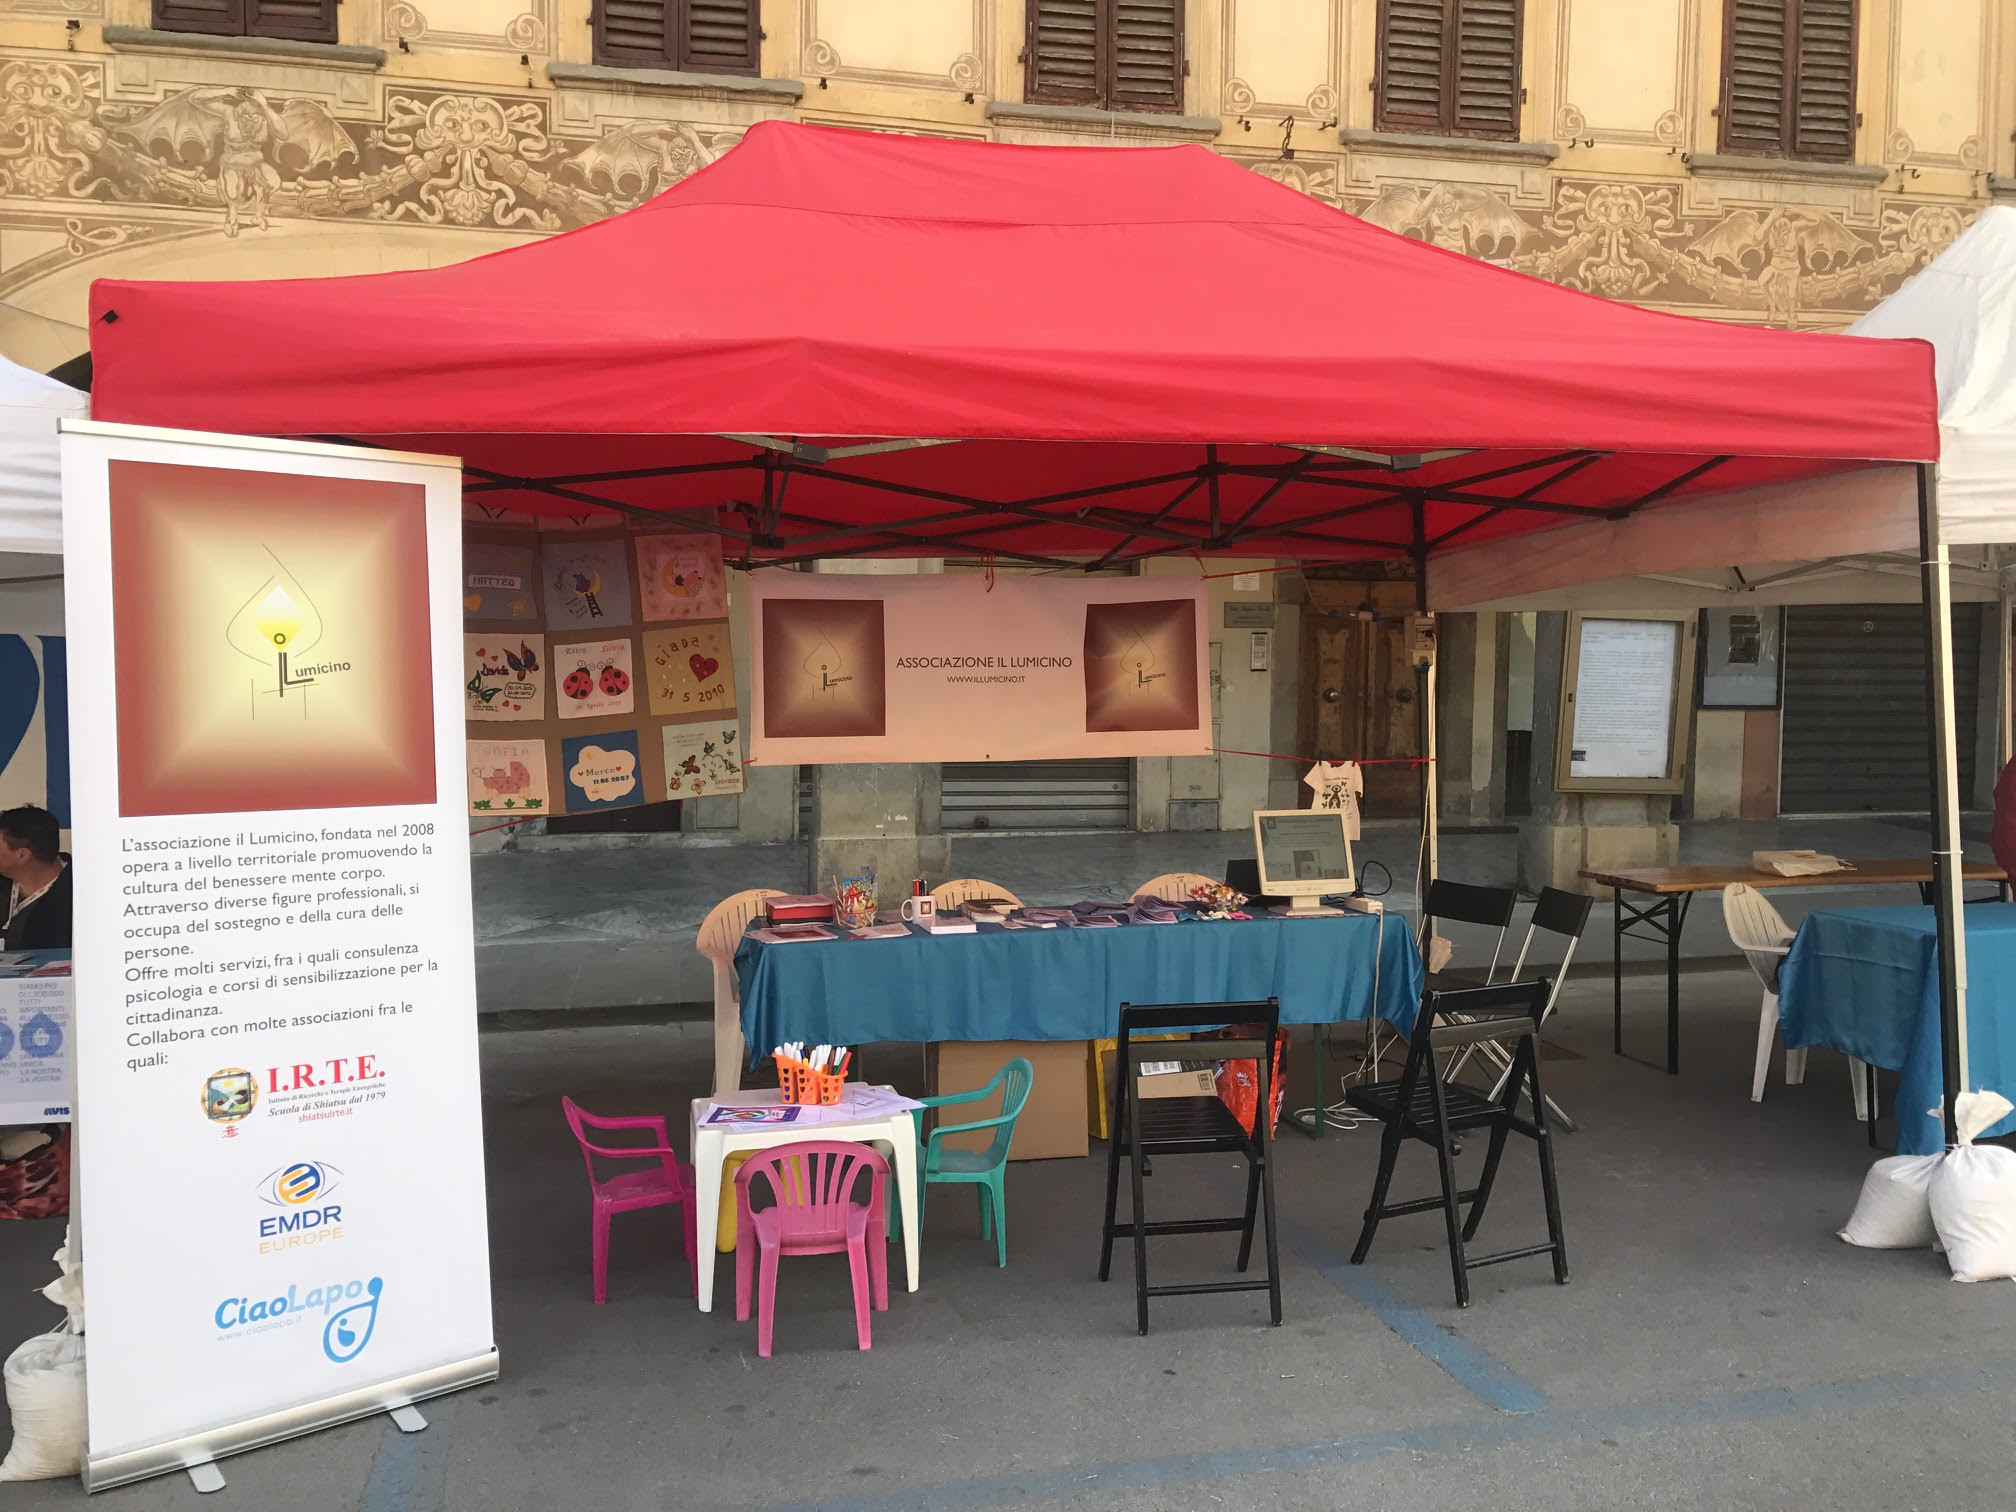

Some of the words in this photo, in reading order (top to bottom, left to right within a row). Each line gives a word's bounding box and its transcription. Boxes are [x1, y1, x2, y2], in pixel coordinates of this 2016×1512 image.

[896, 656, 994, 668] ASSOCIAZIONE
[997, 656, 1008, 668] IL
[1011, 656, 1073, 668] LUMICINO
[698, 683, 725, 703] 2010
[946, 675, 1026, 684] WWW.ILLUMICINO.IT
[122, 836, 231, 852] L'associazione
[236, 833, 244, 846] il
[250, 831, 318, 845] Lumicino,
[321, 827, 372, 841] fondata
[377, 825, 397, 838] nel
[402, 823, 434, 837] 2008
[122, 862, 169, 877] opera
[174, 861, 183, 870] a
[188, 854, 232, 870] livello
[237, 850, 317, 866] territoriale
[321, 843, 418, 865] promuovendo
[422, 843, 432, 855] la
[123, 881, 179, 895] cultura
[184, 877, 207, 891] del
[213, 875, 287, 889] benessere
[292, 872, 336, 883] mente
[341, 869, 385, 882] corpo.
[123, 902, 209, 917] Attraverso
[214, 896, 267, 910] diverse
[272, 892, 312, 908] figure
[317, 883, 406, 906] professionali,
[410, 883, 419, 895] si
[124, 925, 181, 939] occupa
[186, 918, 209, 933] del
[214, 917, 281, 931] sostegno
[286, 915, 294, 925] e
[299, 909, 331, 923] della
[336, 909, 366, 920] cura
[371, 904, 403, 917] delle
[124, 945, 194, 964] persone.
[125, 966, 168, 982] Offre
[174, 961, 214, 977] molti
[219, 956, 271, 972] servizi,
[274, 953, 293, 967] fra
[299, 953, 302, 964] i
[307, 948, 339, 967] quali
[344, 943, 419, 960] consulenza
[126, 984, 203, 1008] psicologia
[208, 985, 217, 994] e
[223, 977, 259, 993] corsi
[265, 975, 277, 988] di
[283, 966, 396, 987] sensibilizzazione
[401, 963, 423, 978] per
[428, 959, 438, 971] la
[126, 1006, 223, 1025] cittadinanza.
[127, 1028, 205, 1047] Collabora
[211, 1024, 238, 1036] con
[244, 1017, 287, 1032] molte
[292, 1005, 373, 1026] associazioni
[378, 1003, 396, 1016] fra
[401, 1001, 413, 1013] le
[127, 1052, 168, 1072] quali:
[266, 1054, 386, 1094] I.R.T.E.
[268, 1105, 300, 1117] Scuola
[302, 1102, 312, 1111] di
[313, 1098, 347, 1110] Shiatsu
[348, 1094, 363, 1104] dal
[365, 1091, 386, 1102] 1979
[298, 1107, 353, 1123] shiatsuirte.it
[260, 1205, 342, 1238] EMDR
[258, 1227, 344, 1255] EUROPE
[215, 1279, 363, 1330] CiaoLapo
